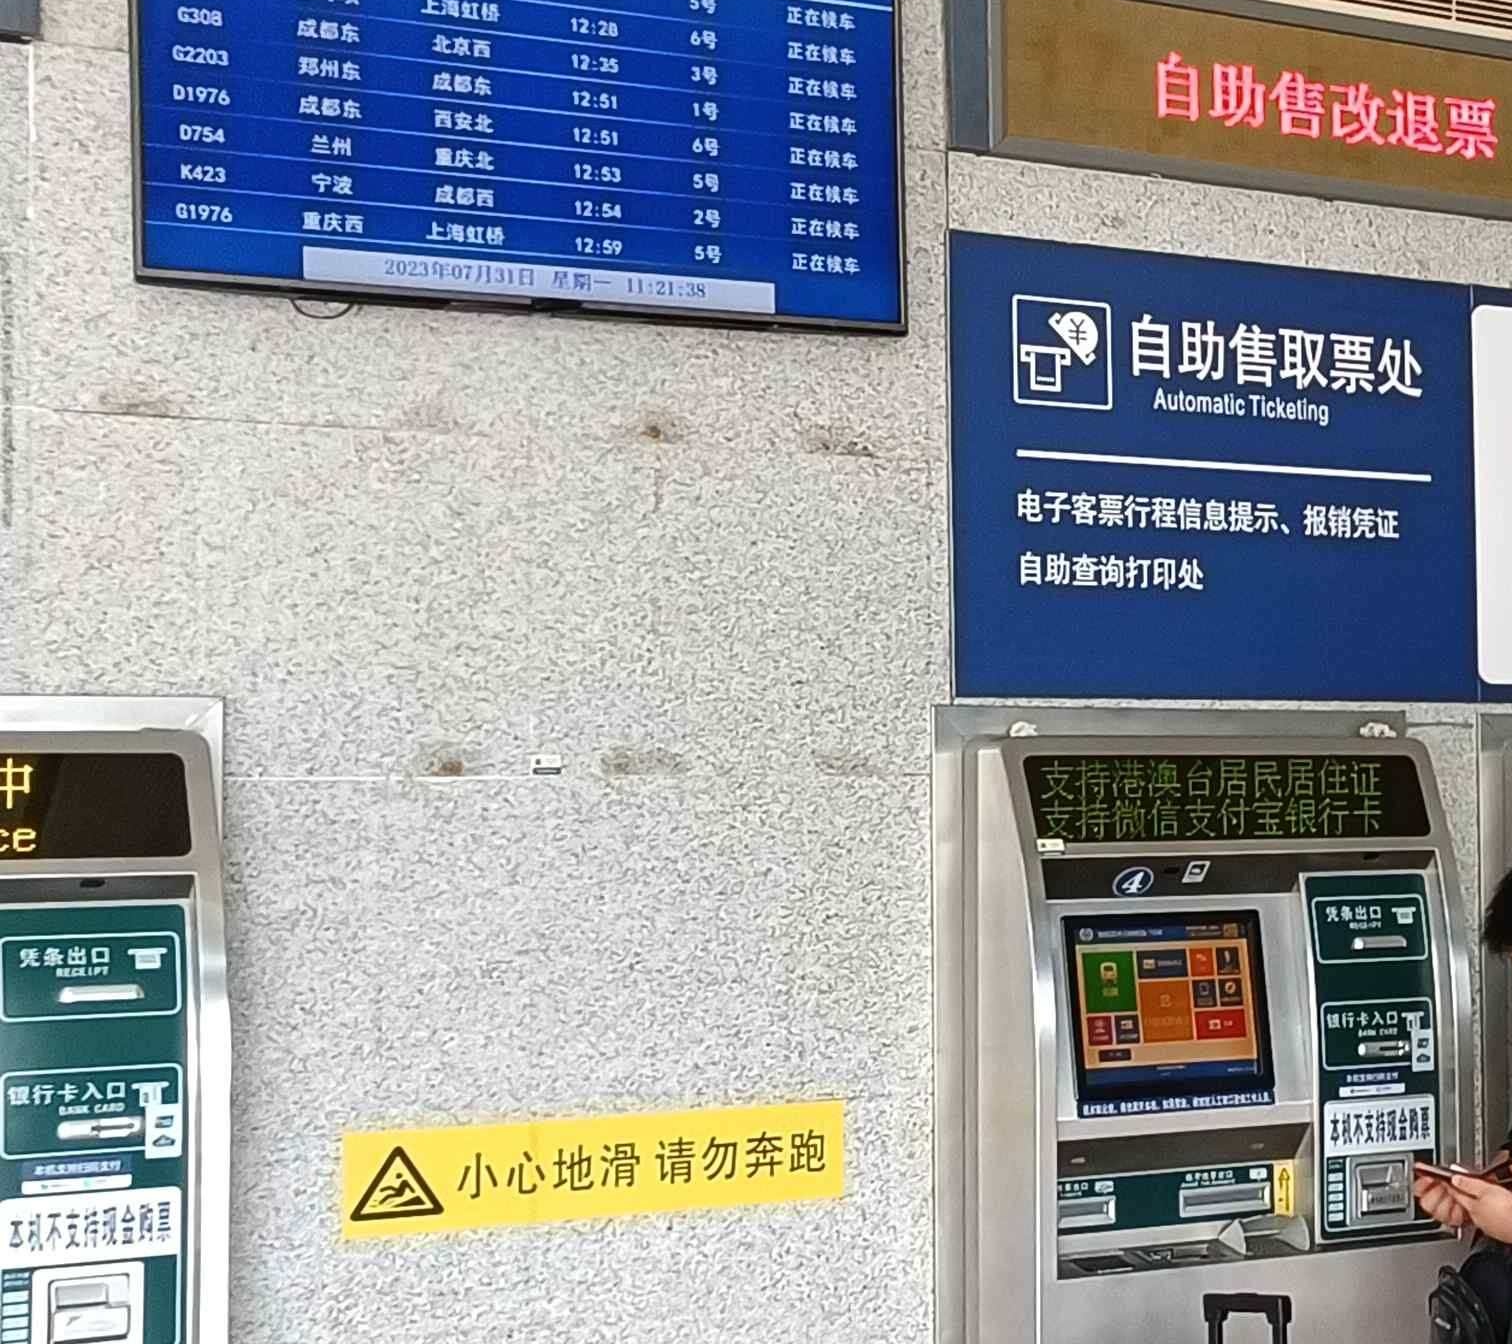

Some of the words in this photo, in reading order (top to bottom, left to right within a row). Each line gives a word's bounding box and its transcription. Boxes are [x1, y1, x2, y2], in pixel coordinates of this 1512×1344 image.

[787, 6, 856, 31] 正在候车
[177, 6, 223, 27] G308
[297, 18, 360, 43] 成都东
[431, 33, 491, 59] 北京西
[691, 66, 719, 86] 3号
[788, 76, 857, 101] 正在候车
[690, 30, 719, 51] 6号
[787, 41, 857, 66] 正在候车
[171, 44, 229, 68] G2203
[297, 55, 361, 82] 郑州东
[431, 72, 492, 97] 成都东
[571, 90, 619, 111] 12:51
[692, 102, 720, 121] 1号
[788, 111, 858, 136] 正在候车
[1156, 50, 1498, 160] 自助售改退票
[172, 83, 231, 106] D1976
[298, 95, 362, 120] 成都东
[433, 108, 494, 135] 西安北
[572, 126, 620, 147] 12:51
[692, 138, 721, 157] 6号
[789, 146, 859, 171] 正在候车
[179, 122, 226, 145] D754
[310, 133, 353, 157] 兰州
[434, 146, 495, 172] 重庆北
[573, 163, 622, 184] 12:53
[693, 174, 721, 193] 5号
[790, 181, 859, 206] 正在候车
[180, 162, 227, 184] K423
[310, 171, 354, 196] 宁波
[434, 184, 495, 208] 成都西
[574, 199, 622, 220] 12:54
[693, 209, 722, 229] 2号
[791, 216, 860, 241] 正在候车
[175, 201, 233, 224] G1976
[301, 210, 364, 235] 重庆西
[425, 220, 506, 247] 上海虹桥
[575, 236, 623, 257] 12:59
[694, 245, 723, 264] 5号
[791, 252, 861, 276] 正在候车
[384, 258, 535, 287] 2023年07月31日
[551, 271, 611, 292] 星期一
[627, 278, 706, 298] 11:21:38
[1131, 313, 1423, 399] 自助售取票处
[1153, 388, 1245, 418] Automatic
[1250, 395, 1329, 426] Ticketing
[1016, 488, 1400, 540] 电子客票行程信息提示、报销凭证
[1019, 552, 1205, 592] 自助查询打印处
[1040, 760, 1383, 799] 支持港澳台居民居住证
[1040, 798, 1383, 841] 支持微信支付宝银行卡
[1325, 906, 1382, 922] 凭条出口
[18, 945, 111, 969] 凭条出口
[1327, 1011, 1398, 1029] 银行卡入口
[7, 1081, 126, 1105] 银行卡入口
[1330, 1105, 1430, 1146] 本机不支持现金购票
[457, 1141, 640, 1200] 小心地滑
[655, 1130, 826, 1185] 请勿奔跑
[8, 1201, 172, 1252] 本机不支持现金购票
